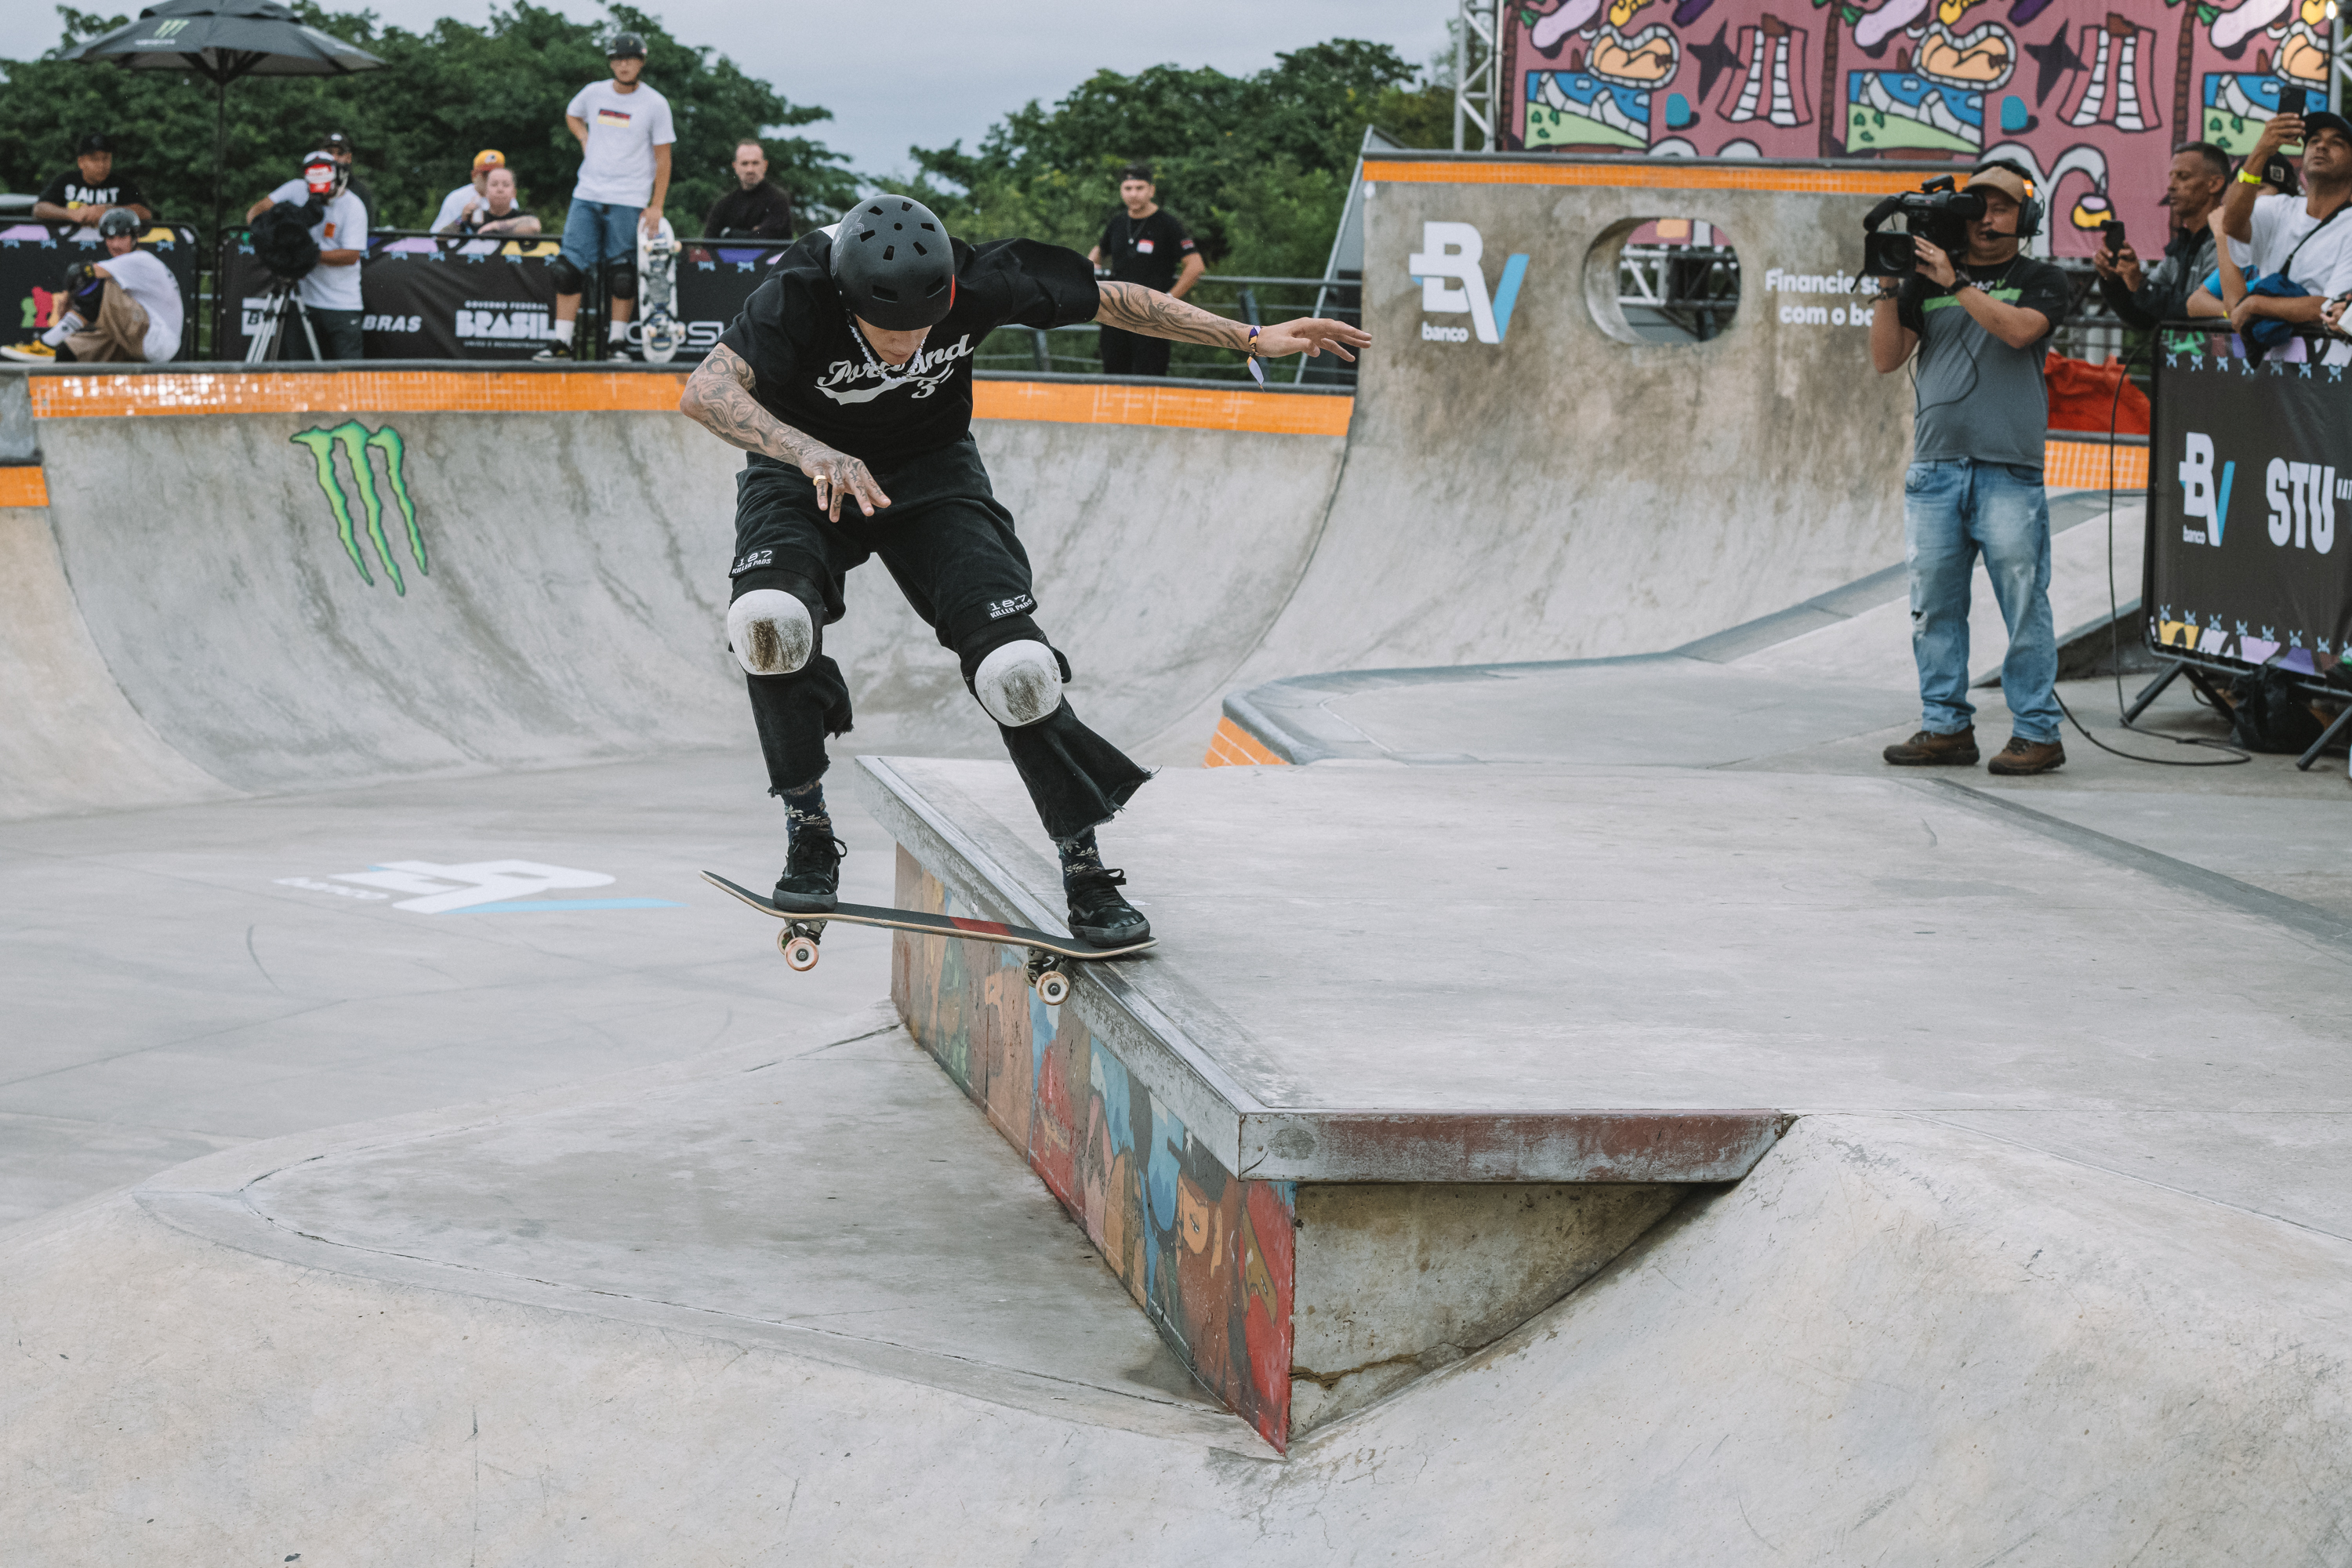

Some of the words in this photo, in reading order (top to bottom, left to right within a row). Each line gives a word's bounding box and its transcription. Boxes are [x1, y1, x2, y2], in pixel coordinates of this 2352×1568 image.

[64, 184, 119, 205] SAINT
[1765, 267, 1857, 294] Financie
[456, 310, 557, 339] BRASIL
[1780, 305, 1828, 325] com
[1831, 307, 1846, 326] o
[1421, 321, 1468, 343] banco
[911, 379, 939, 398] 3
[2266, 457, 2336, 554] STU
[2183, 524, 2206, 545] banco
[731, 562, 753, 574] KILLER
[737, 550, 773, 567] 187
[990, 594, 1026, 611] 187
[990, 607, 1015, 619] KILLER
[1014, 598, 1033, 611] PADS
